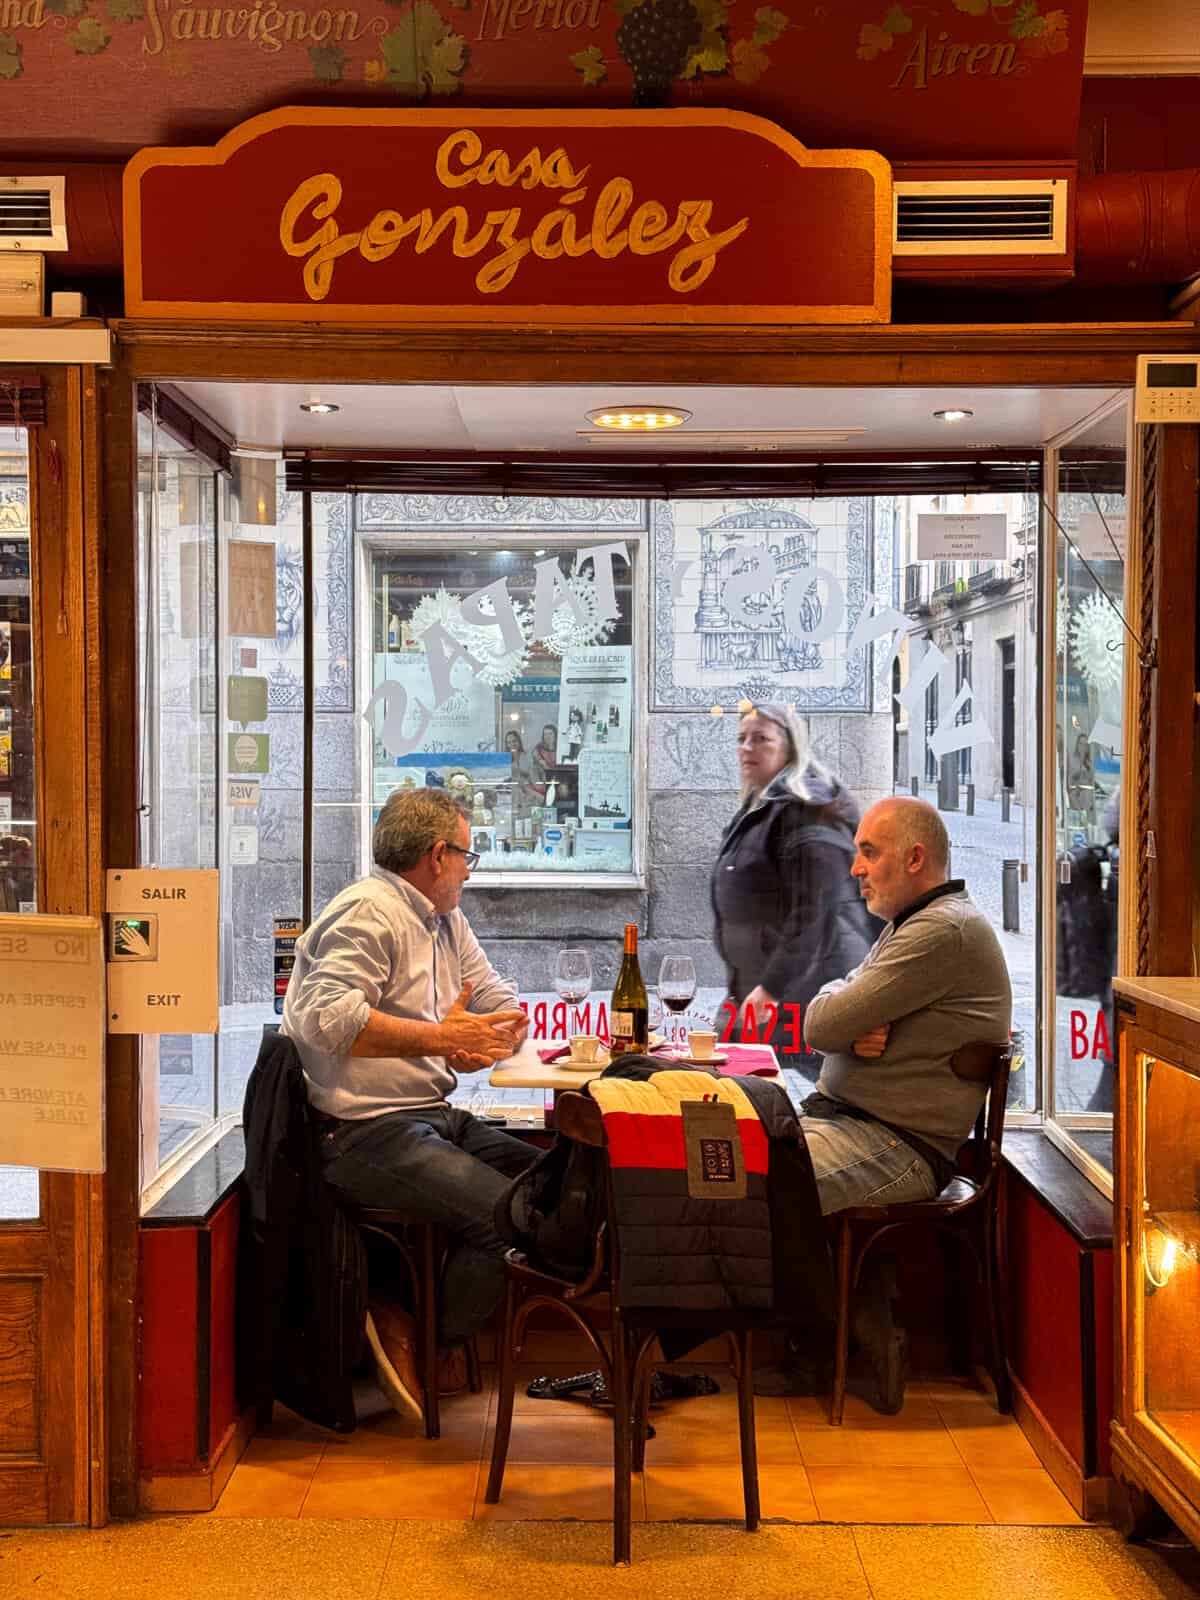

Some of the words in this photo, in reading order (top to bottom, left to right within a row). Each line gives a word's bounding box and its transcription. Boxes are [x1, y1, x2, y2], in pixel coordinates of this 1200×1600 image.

[144, 0, 372, 54] Sauvignon
[436, 129, 591, 189] Casa
[279, 173, 749, 300] González
[141, 888, 187, 900] SALIR
[146, 994, 182, 1007] EXIT
